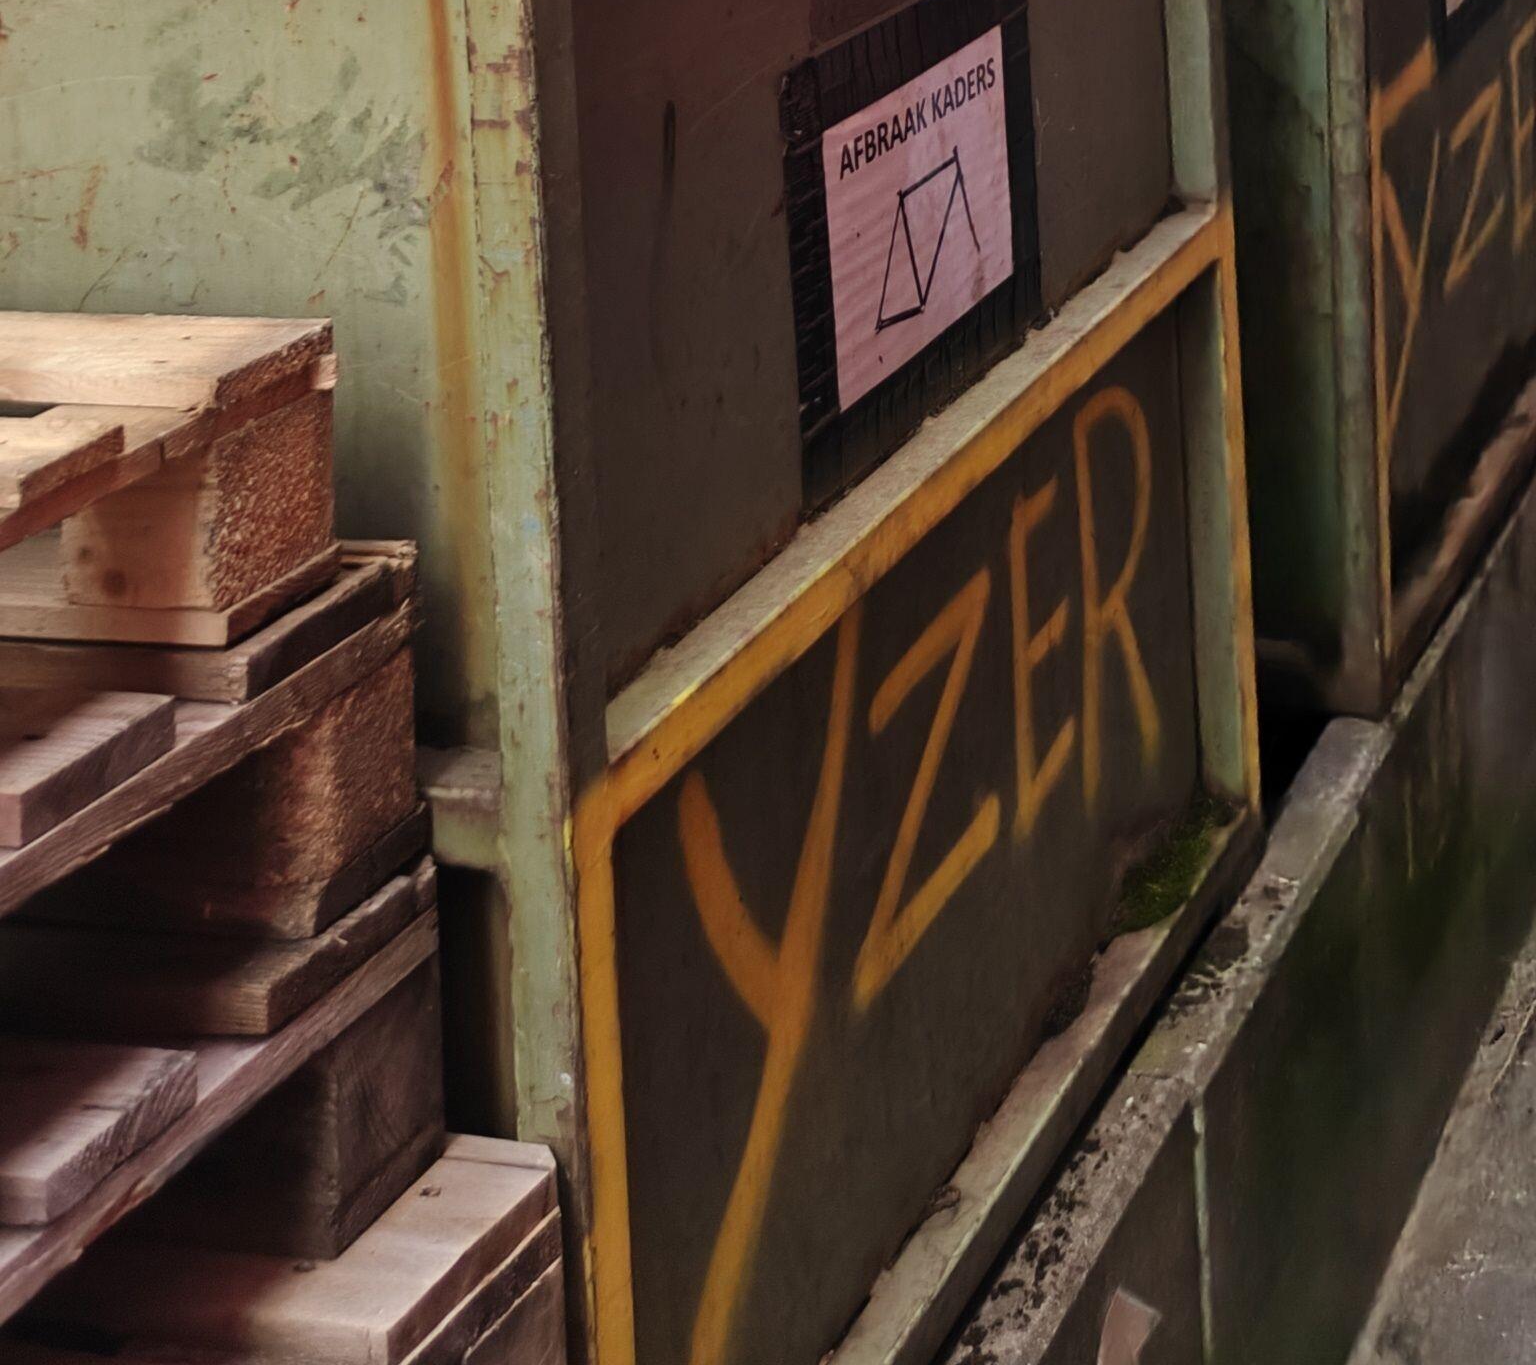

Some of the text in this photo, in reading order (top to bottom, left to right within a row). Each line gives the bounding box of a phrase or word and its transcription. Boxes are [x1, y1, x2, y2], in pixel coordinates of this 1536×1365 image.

[840, 57, 996, 181] AFBRAAK KADERS
[677, 386, 1162, 1365] YZER
